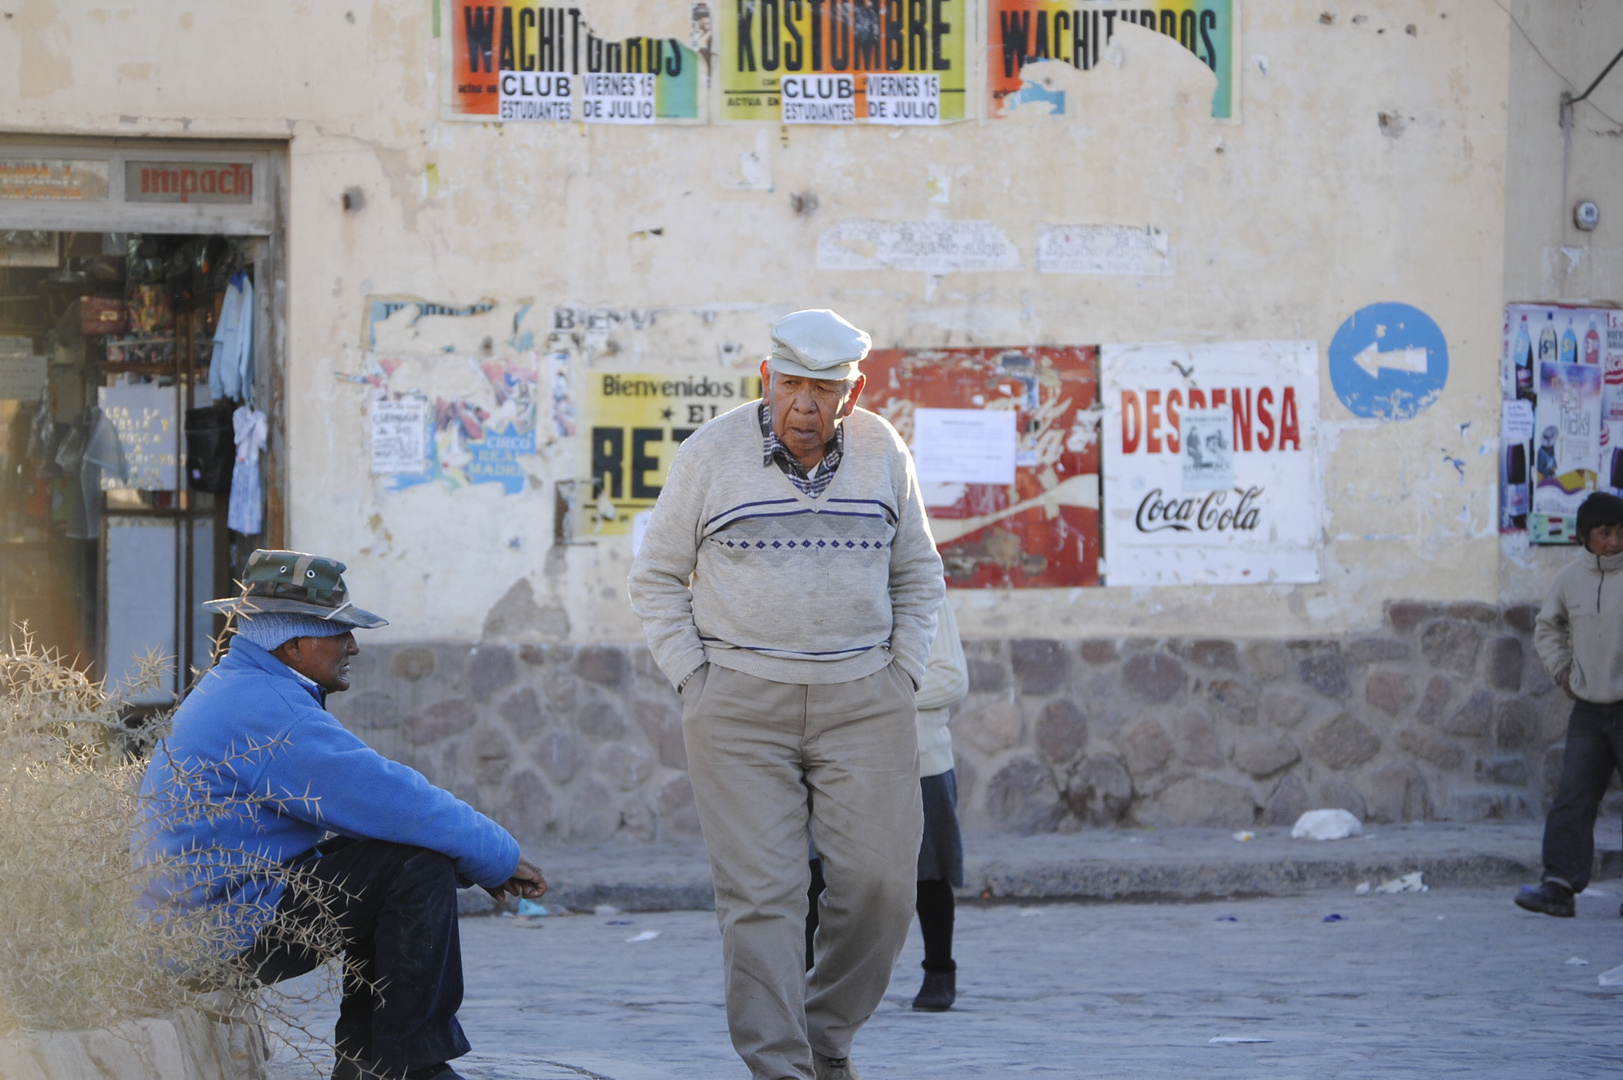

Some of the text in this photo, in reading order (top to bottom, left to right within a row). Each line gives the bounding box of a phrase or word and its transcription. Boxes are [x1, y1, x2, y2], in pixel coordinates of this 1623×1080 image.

[737, 0, 951, 71] KOSTUMBRE
[1000, 9, 1216, 77] WACHITOS
[502, 75, 571, 97] CLUB
[583, 75, 653, 96] VIERNES 15
[784, 78, 851, 99] CLUB
[868, 76, 938, 98] VIERNES 15
[501, 101, 571, 119] ESTUDIANTES
[584, 102, 652, 119] DE JULIO
[785, 103, 853, 120] ESTUDIANTES
[869, 102, 937, 119] DE JULIO
[603, 375, 735, 398] Bienvenidos
